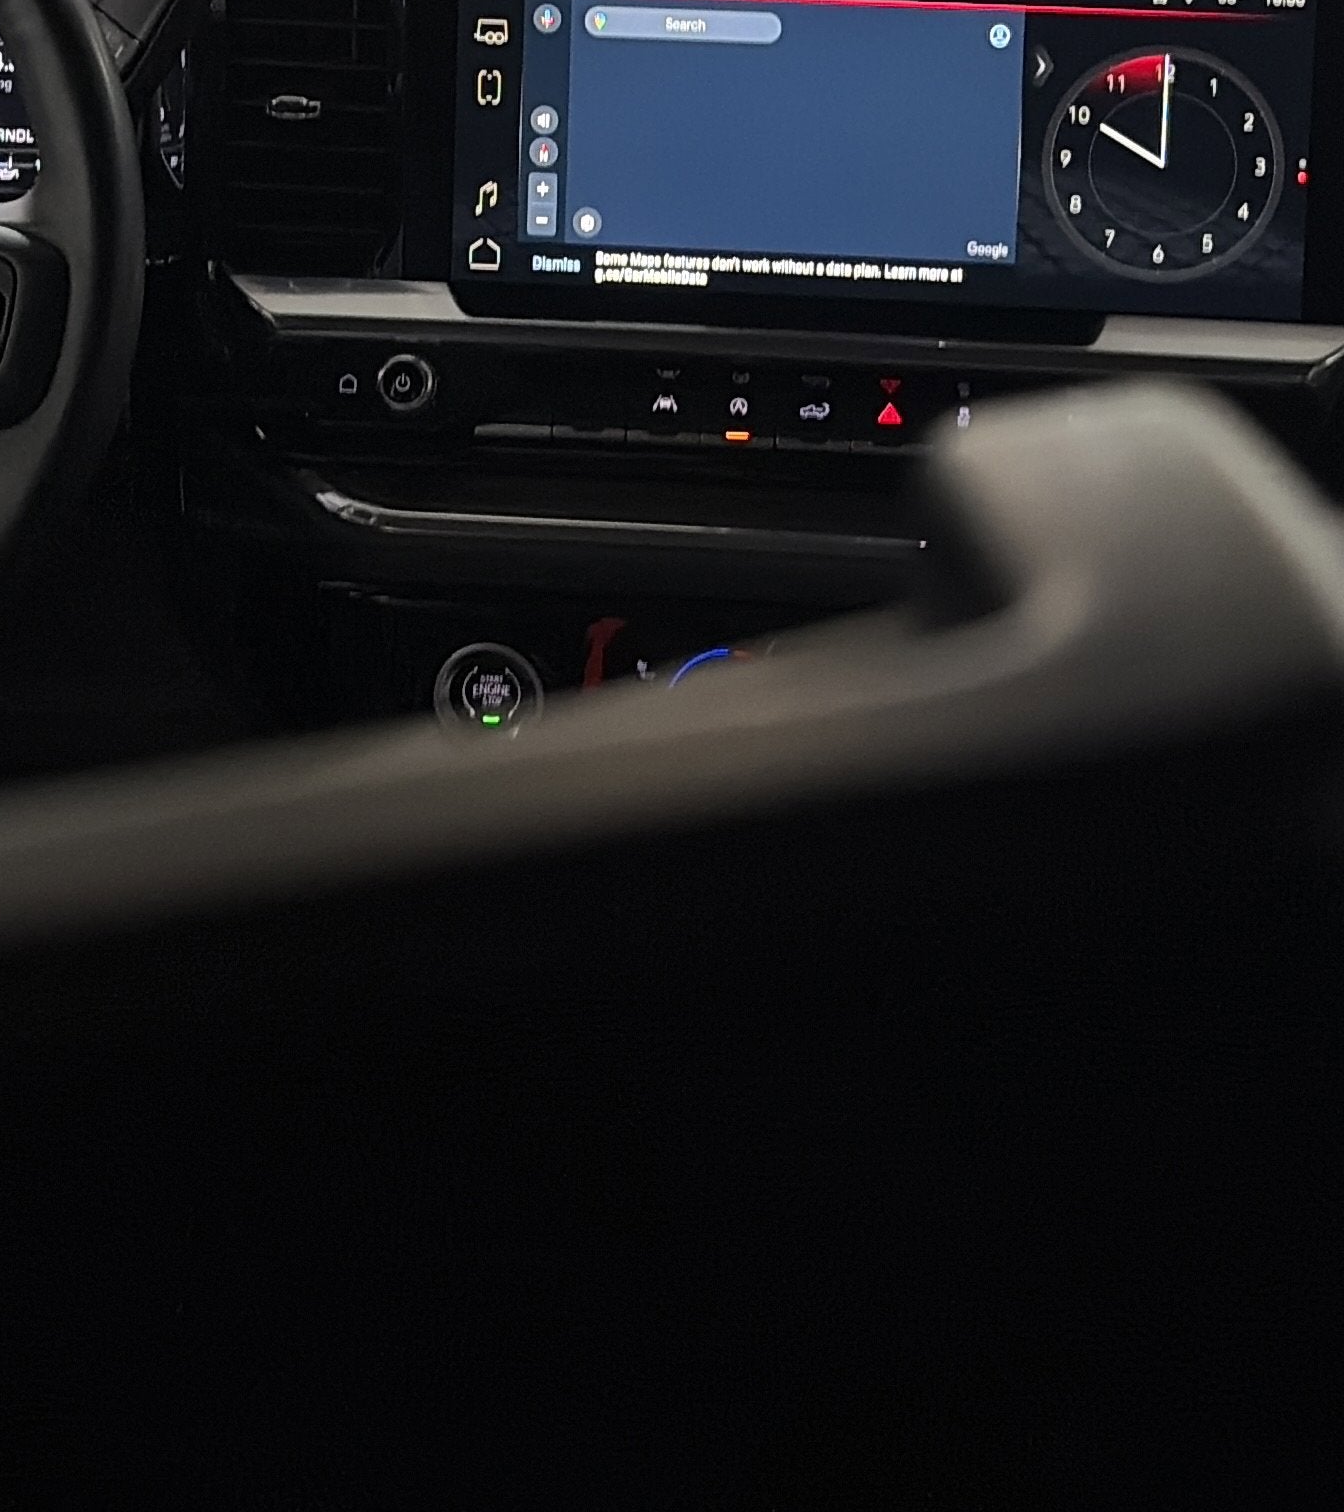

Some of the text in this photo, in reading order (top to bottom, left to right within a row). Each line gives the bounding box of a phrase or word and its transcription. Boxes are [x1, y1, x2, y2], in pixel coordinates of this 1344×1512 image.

[665, 17, 706, 34] Search
[1106, 73, 1125, 94] 11
[1210, 77, 1219, 98] 1
[1068, 105, 1091, 126] 10
[1244, 112, 1255, 133] 2
[1060, 149, 1072, 169] 9
[1255, 157, 1266, 178] 3
[1070, 194, 1082, 215] 8
[1237, 202, 1249, 222] 4
[1104, 228, 1116, 248] 7
[1202, 233, 1213, 254] 5
[967, 240, 1009, 260] Google
[1152, 243, 1165, 265] 6
[532, 254, 581, 273] Dismiss
[595, 250, 628, 267] Some
[629, 251, 662, 269] Maps
[663, 252, 710, 271] features
[712, 255, 741, 272] don't
[742, 257, 770, 274] work
[771, 258, 814, 277] without
[816, 261, 824, 276] a
[826, 260, 852, 278] data
[884, 263, 917, 281] Learn
[918, 266, 949, 283] more
[950, 267, 964, 284] at
[472, 683, 511, 699] ENGINE
